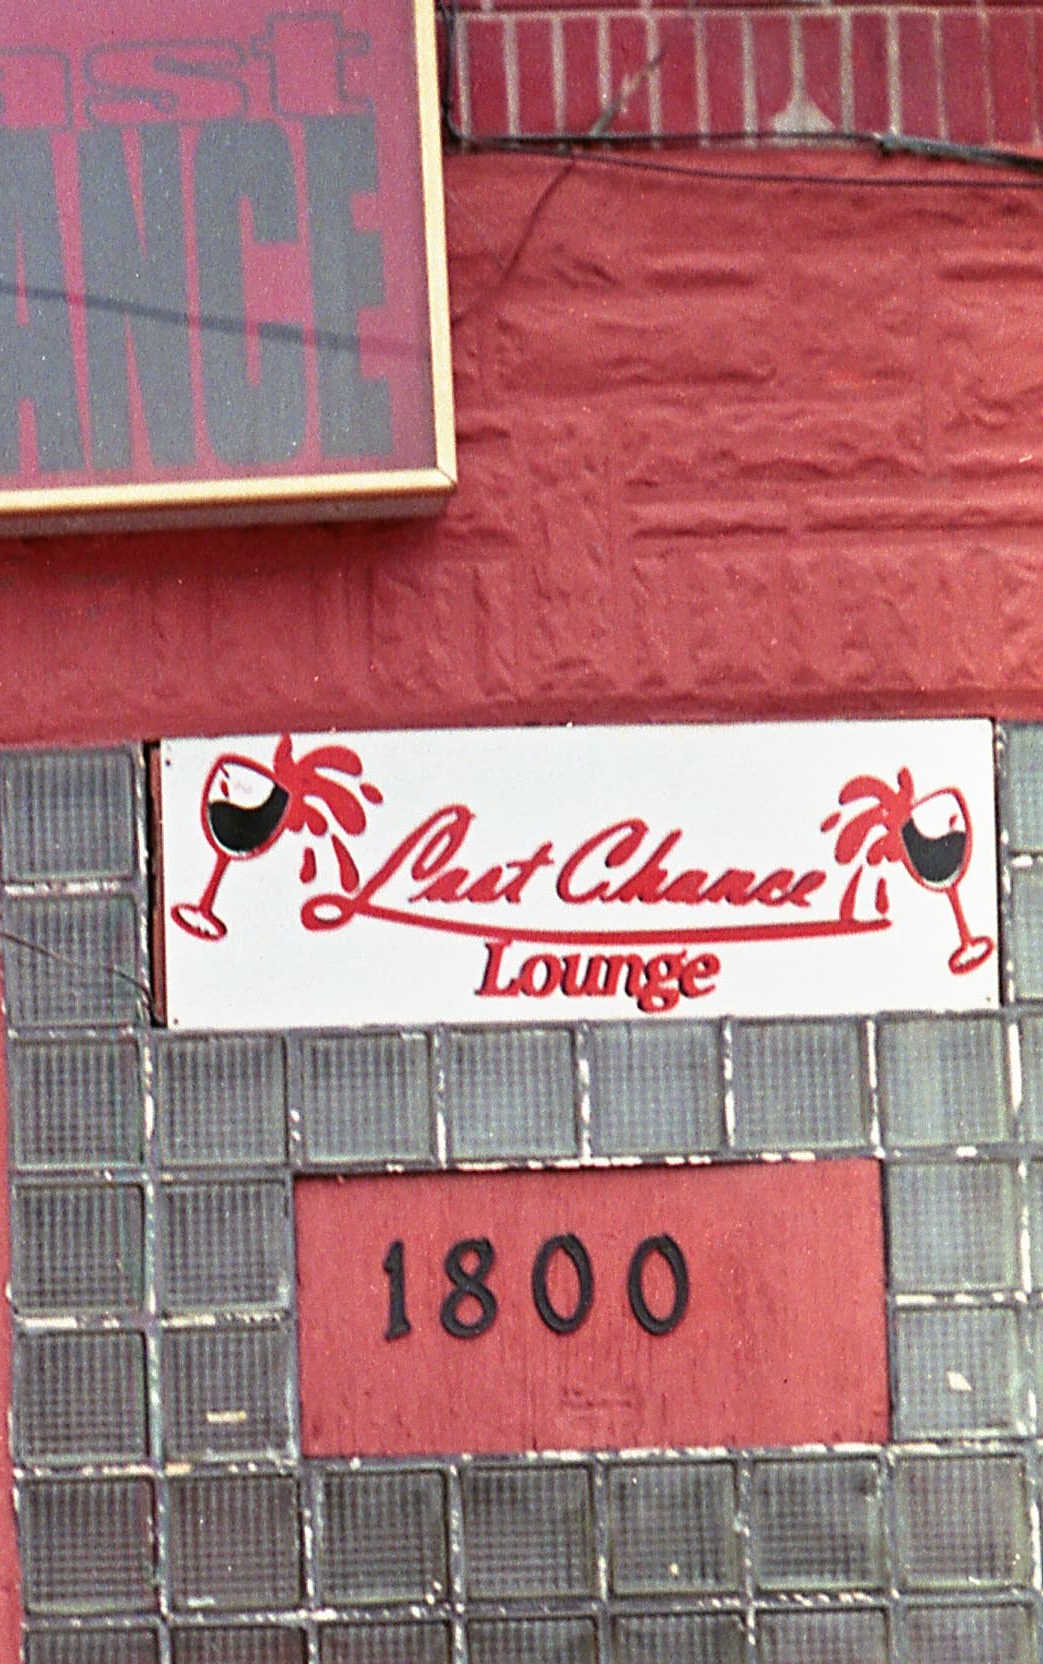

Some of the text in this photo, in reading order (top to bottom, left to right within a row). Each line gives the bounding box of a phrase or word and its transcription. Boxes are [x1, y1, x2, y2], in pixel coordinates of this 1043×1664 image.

[301, 803, 826, 932] Last Chance
[474, 940, 722, 1014] Lounge
[382, 1231, 690, 1343] 1800
